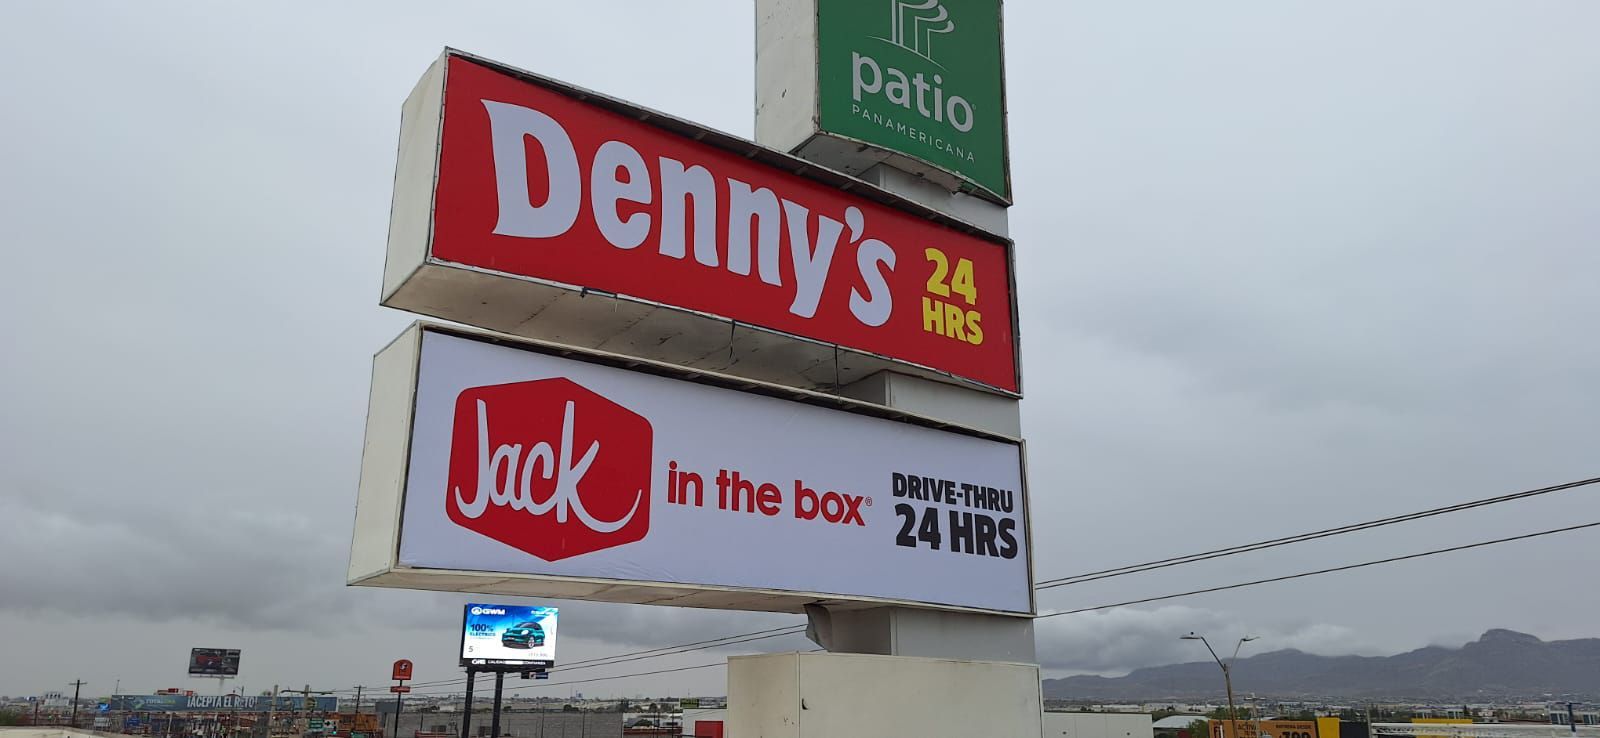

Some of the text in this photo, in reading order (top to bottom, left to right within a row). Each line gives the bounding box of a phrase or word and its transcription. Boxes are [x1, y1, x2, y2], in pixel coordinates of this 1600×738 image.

[852, 51, 974, 133] patio
[852, 104, 975, 163] PANAMERICANA
[480, 98, 897, 327] Denny's
[925, 247, 977, 306] 24
[922, 296, 984, 345] HRS
[454, 398, 643, 533] Jack
[667, 460, 704, 507] in
[715, 469, 783, 517] the
[892, 471, 1013, 514] DRIVE-THRU
[894, 503, 1018, 560] 24 HRS
[470, 623, 494, 632] 100%
[482, 607, 505, 616] GWM
[187, 696, 221, 708] ¡ACEPTA
[223, 696, 233, 707] EL
